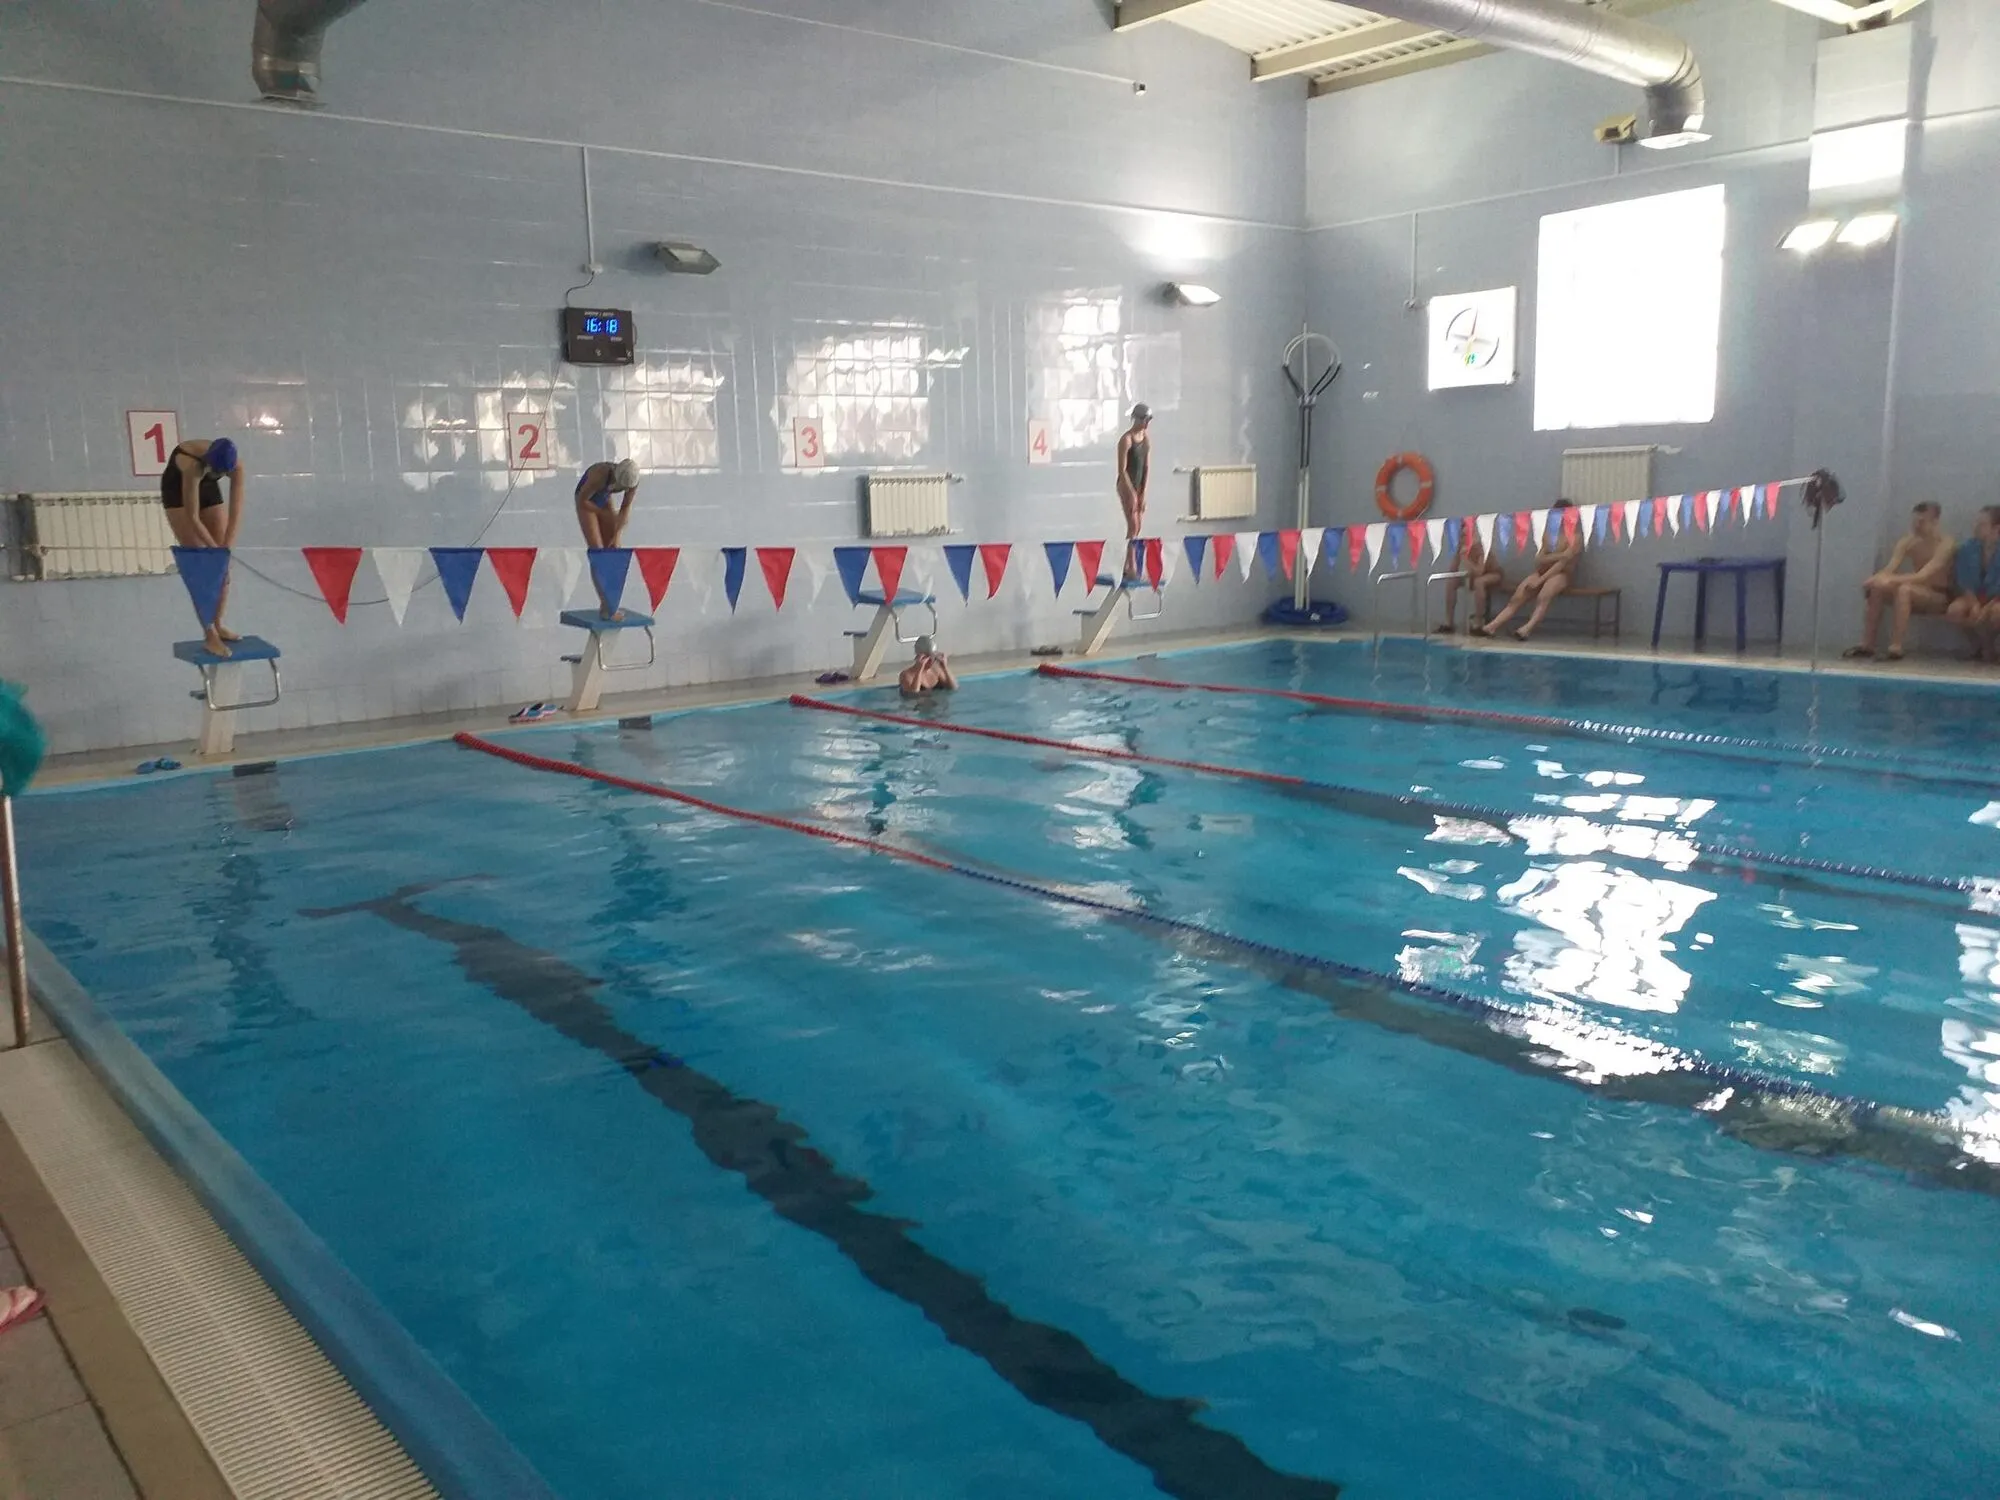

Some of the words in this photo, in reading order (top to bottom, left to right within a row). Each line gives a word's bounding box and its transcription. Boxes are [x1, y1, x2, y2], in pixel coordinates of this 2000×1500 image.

[586, 318, 618, 333] 16:18
[144, 423, 166, 463] 1
[518, 424, 541, 459] 2
[801, 426, 818, 458] 3
[1033, 428, 1048, 456] 4
